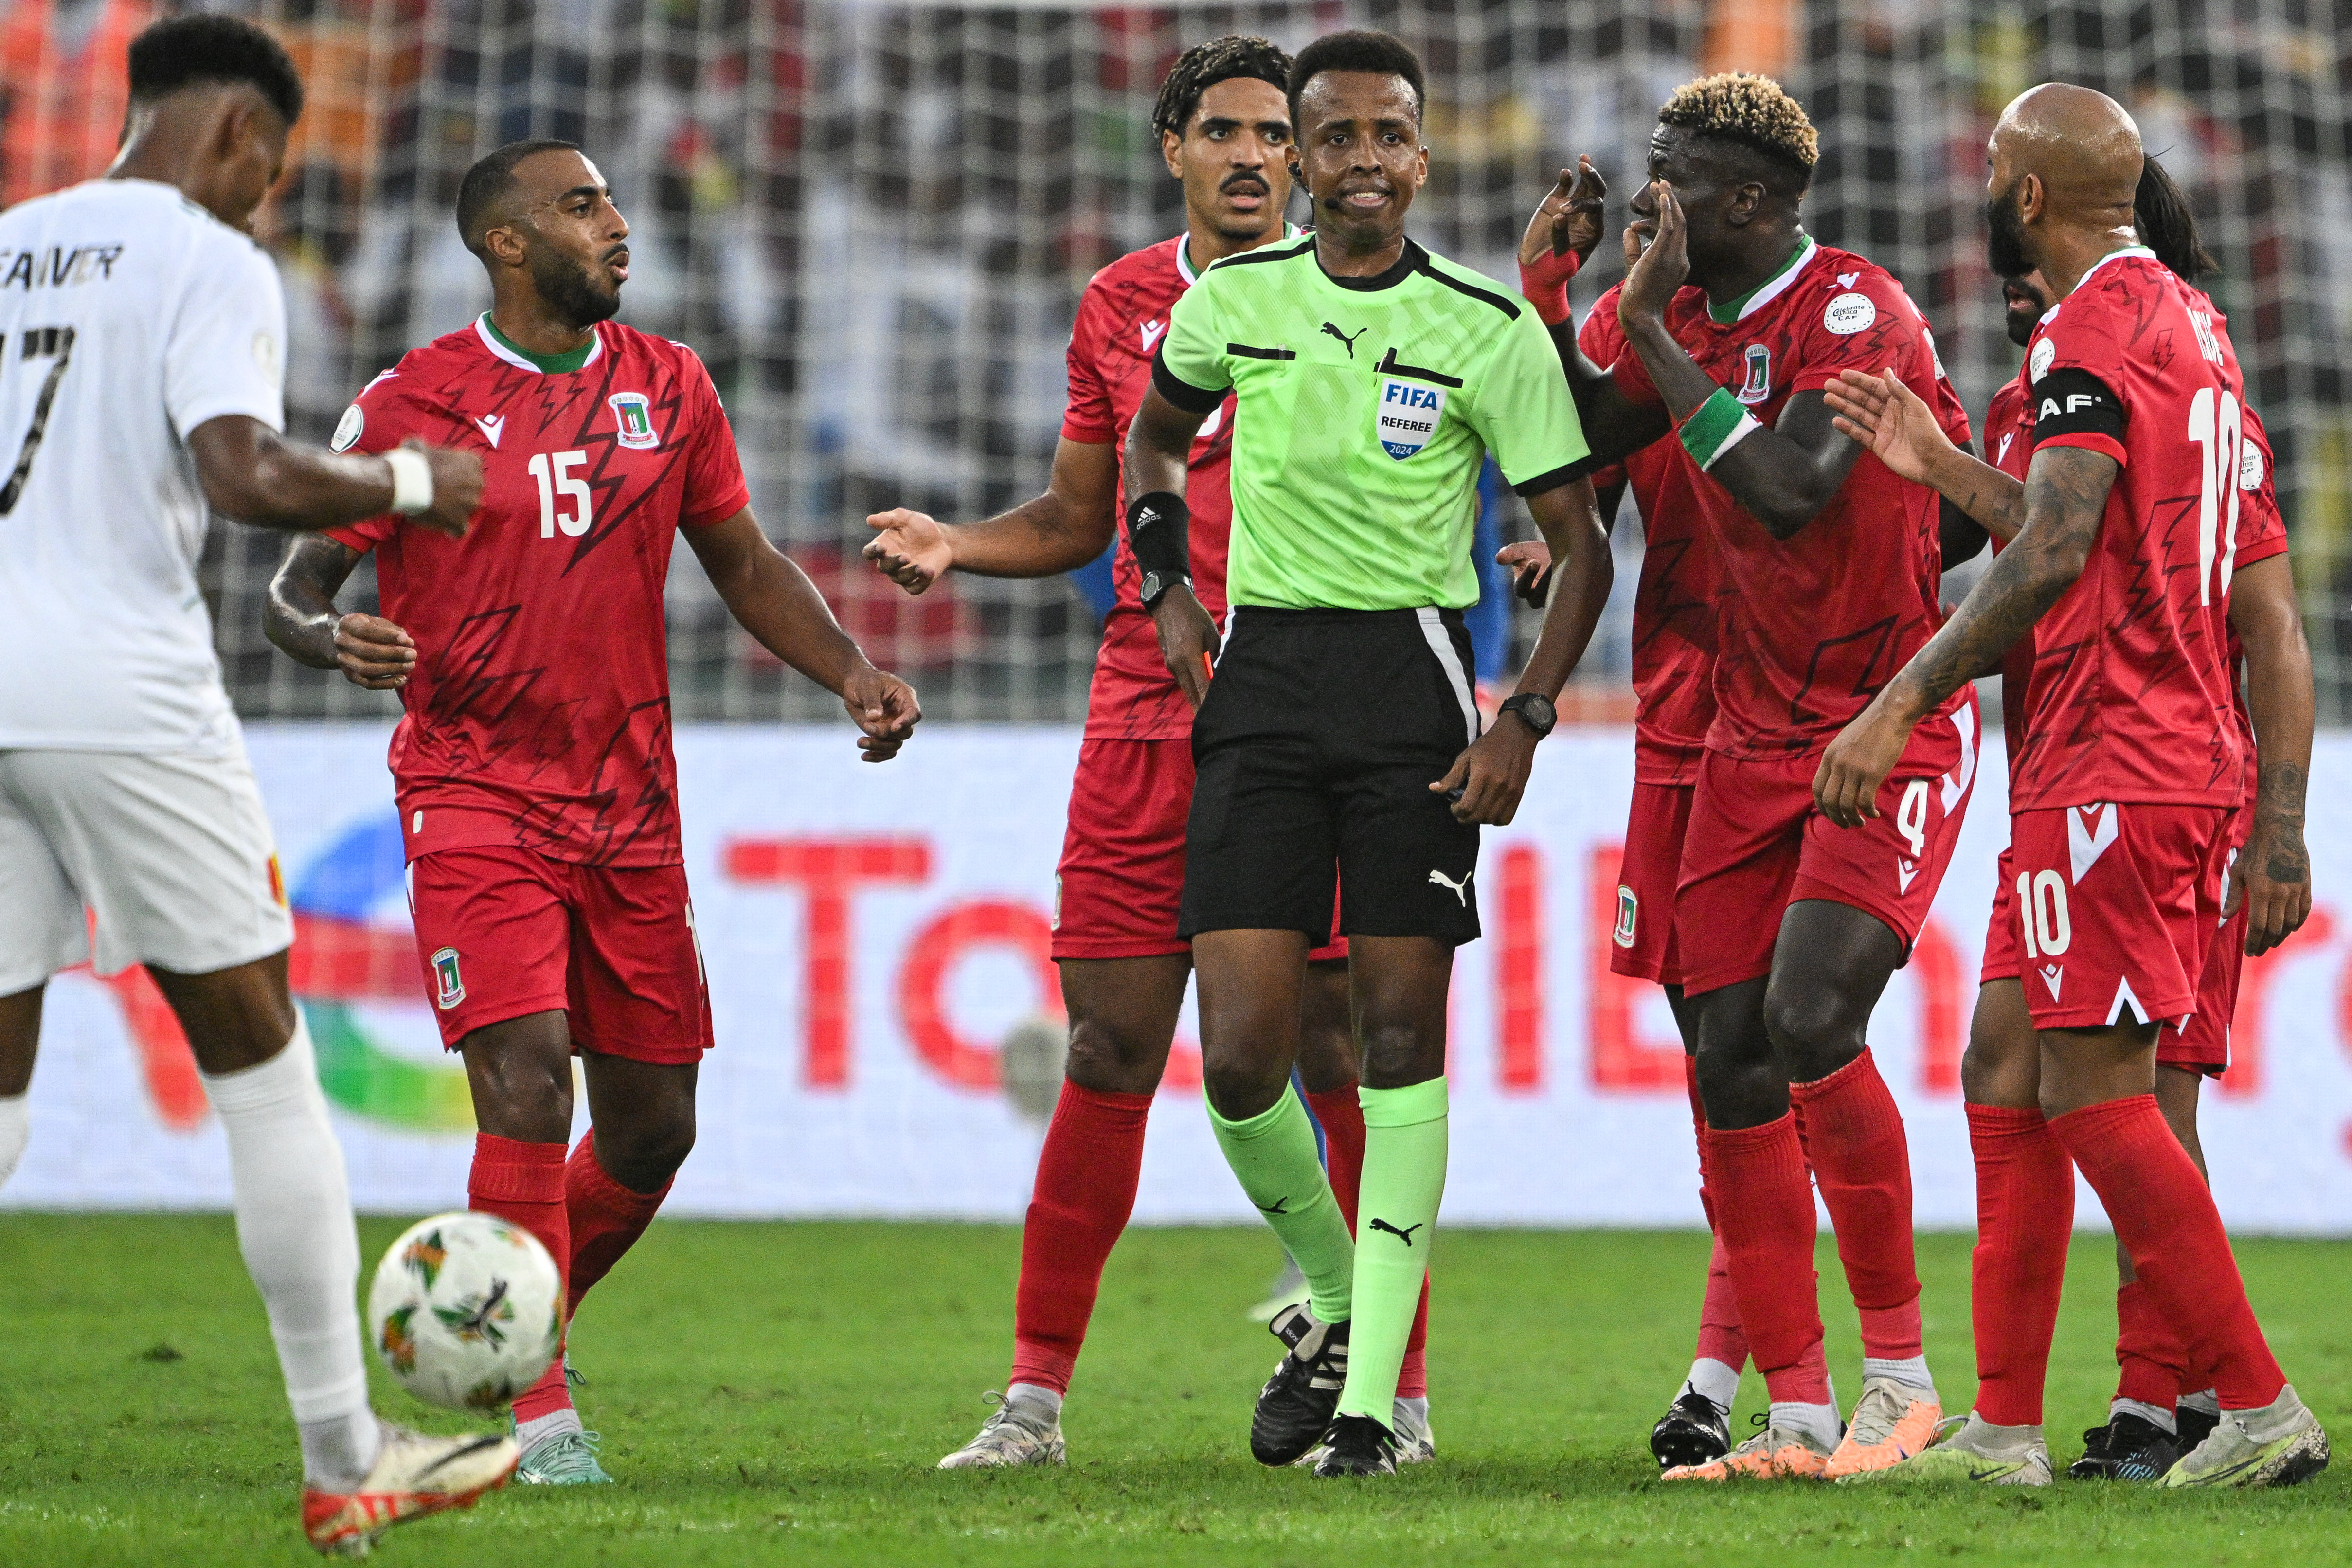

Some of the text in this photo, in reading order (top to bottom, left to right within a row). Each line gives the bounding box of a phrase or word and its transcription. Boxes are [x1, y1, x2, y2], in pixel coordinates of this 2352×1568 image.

[0, 325, 76, 520] 7
[1381, 416, 1432, 433] REFEREE
[1385, 383, 1437, 411] FIFA
[2035, 394, 2092, 425] AF
[1389, 444, 1412, 455] 2024
[528, 449, 592, 539] 15
[1136, 513, 1161, 530] adidas
[2188, 387, 2241, 607] 10
[1897, 779, 1929, 858] 4
[2016, 869, 2072, 959] 10
